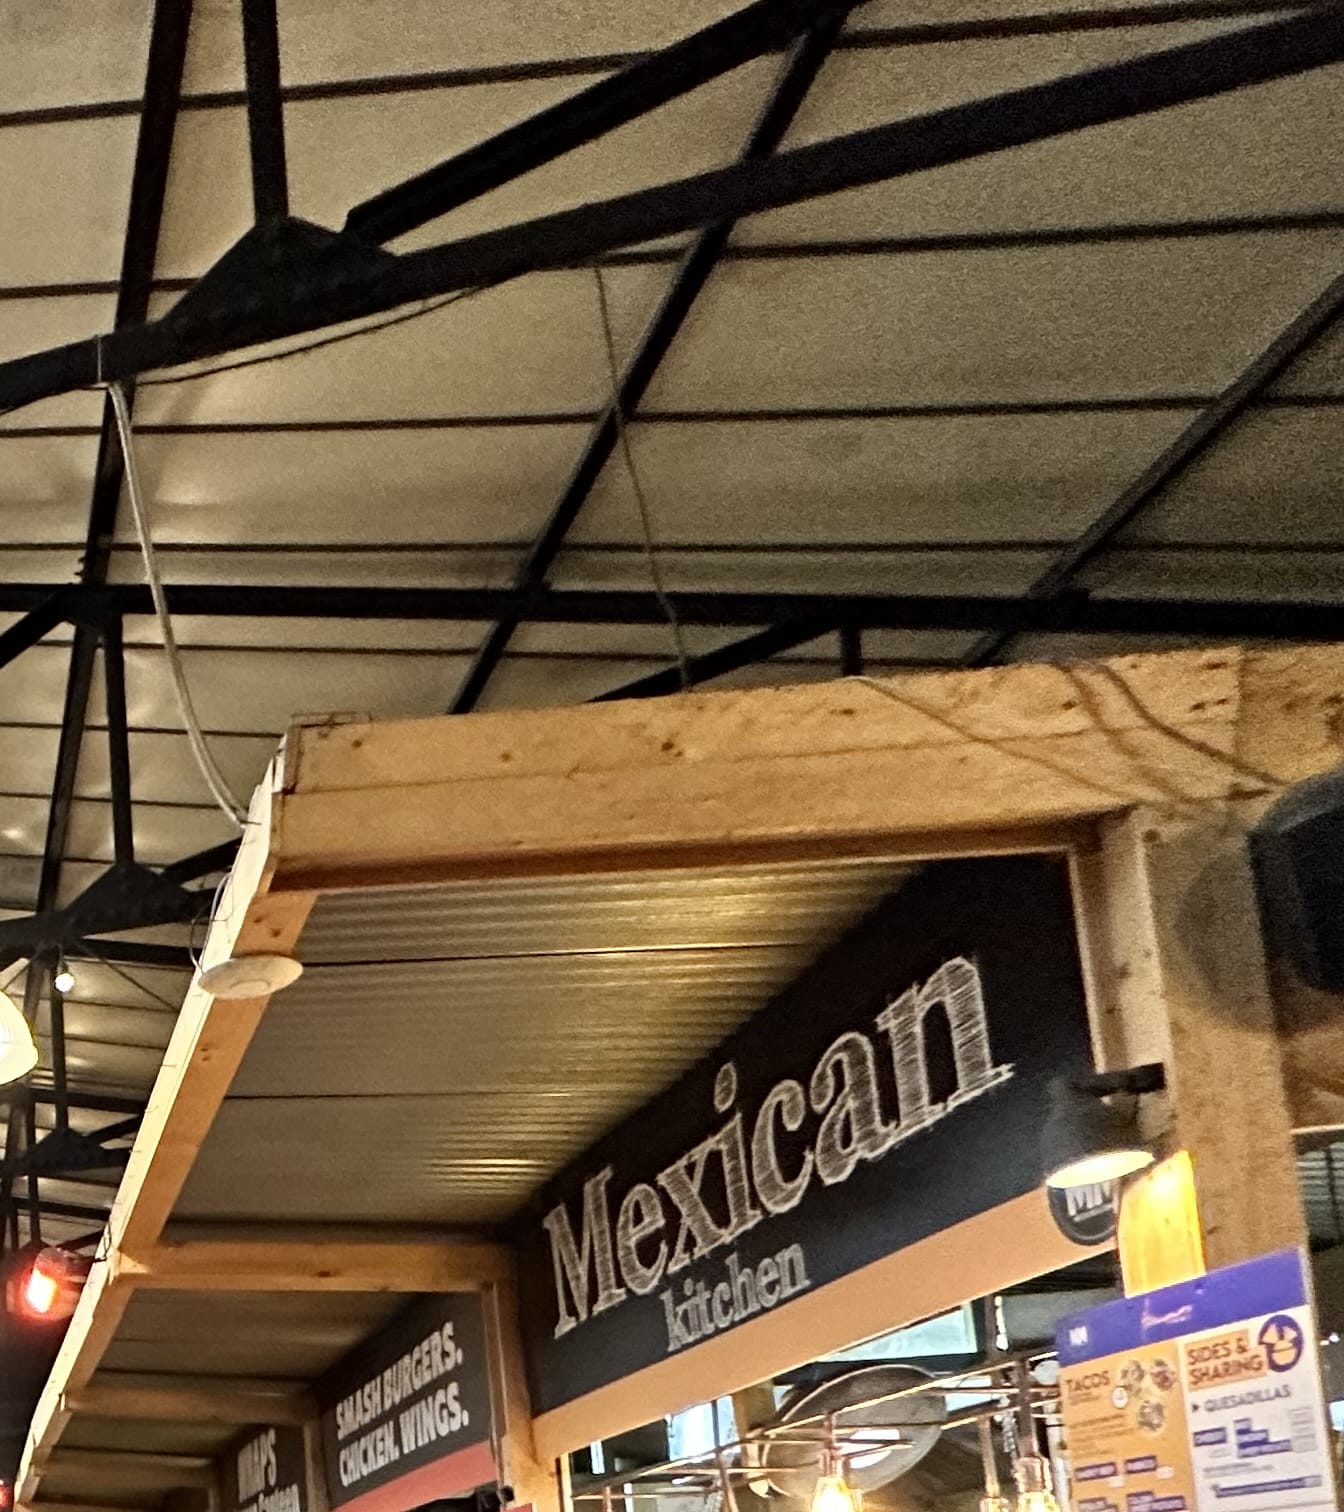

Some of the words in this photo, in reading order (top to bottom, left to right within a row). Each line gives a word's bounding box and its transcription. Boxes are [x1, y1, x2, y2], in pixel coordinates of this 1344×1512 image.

[542, 954, 1016, 1340] Mexican
[661, 1242, 810, 1353] kitchen
[336, 1375, 382, 1441] SMASH
[383, 1320, 463, 1411] BURGERS.
[1066, 1370, 1111, 1392] TACOS
[1188, 1341, 1231, 1366] SIDES
[1189, 1354, 1264, 1386] SHARING
[339, 1420, 400, 1487] CHICKEN.
[399, 1381, 470, 1455] WINGS.
